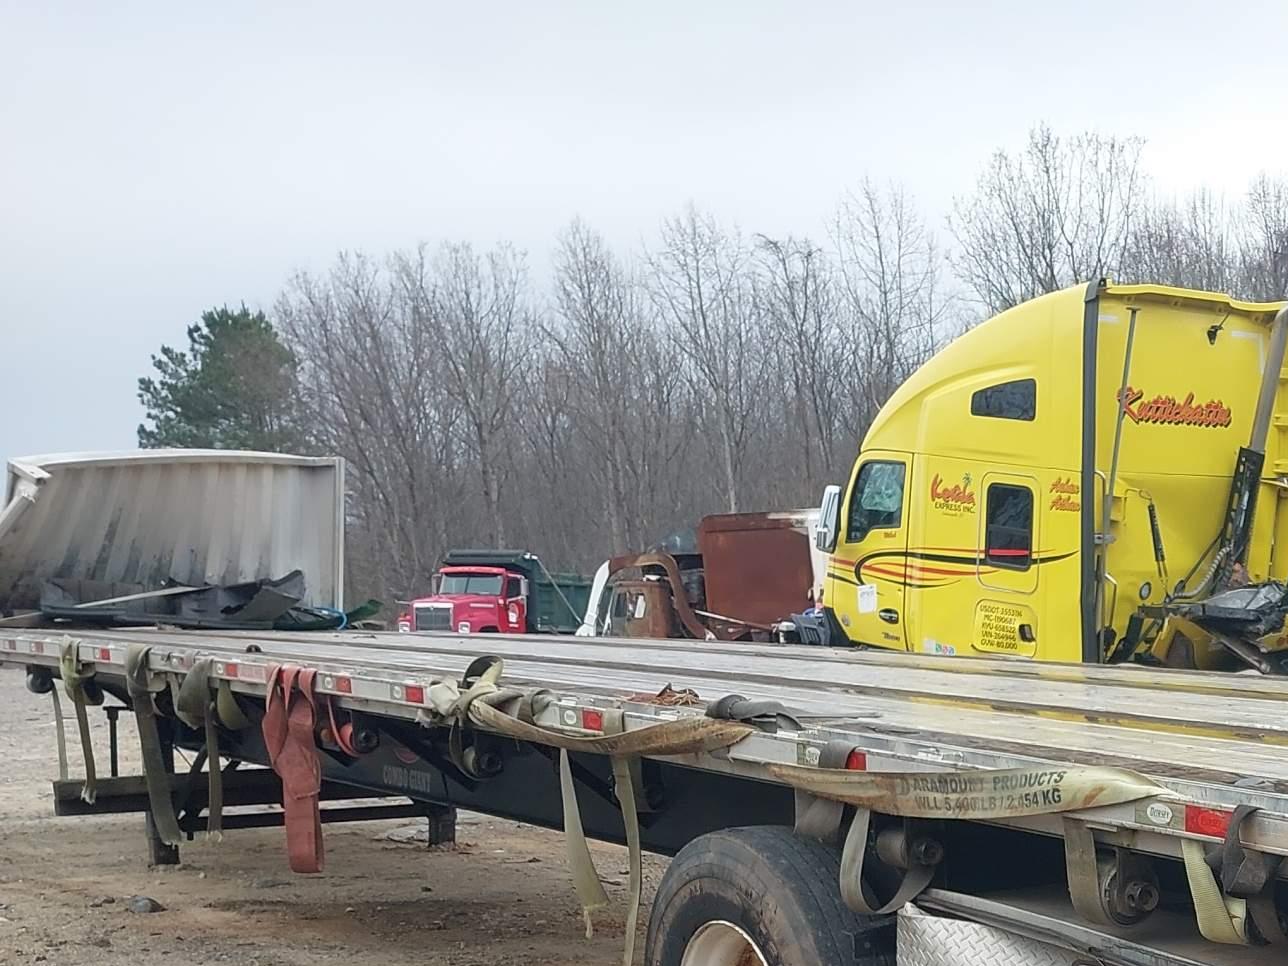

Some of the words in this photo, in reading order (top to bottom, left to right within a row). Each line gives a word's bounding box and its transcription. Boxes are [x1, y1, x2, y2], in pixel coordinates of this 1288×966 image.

[934, 502, 961, 512] EXPRESS
[992, 771, 1067, 791] PRODUCTS
[915, 796, 943, 811] WLL
[980, 796, 997, 811] LB
[1042, 787, 1062, 806] KG
